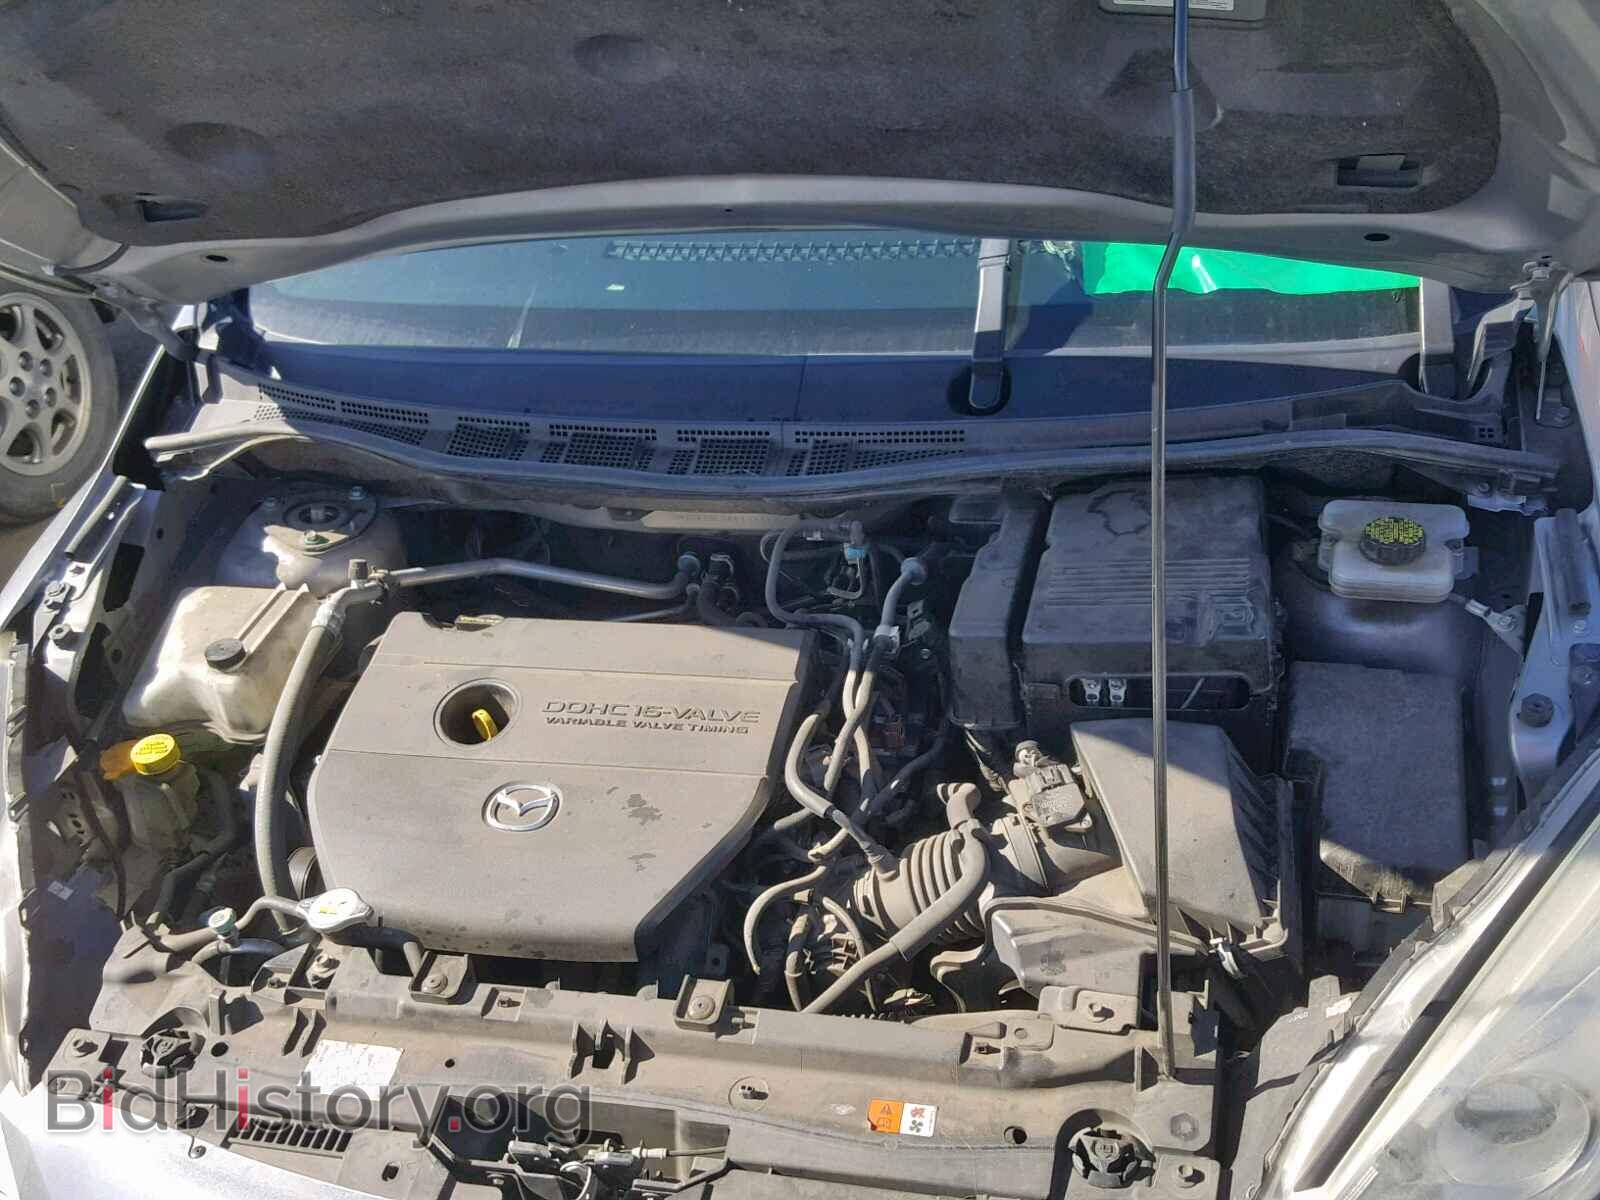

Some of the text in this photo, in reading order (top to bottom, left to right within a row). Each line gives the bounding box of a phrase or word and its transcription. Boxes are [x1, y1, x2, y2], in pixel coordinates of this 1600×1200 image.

[542, 701, 630, 716] DOHC
[546, 716, 749, 735] VARIABLE VALVE TIMING
